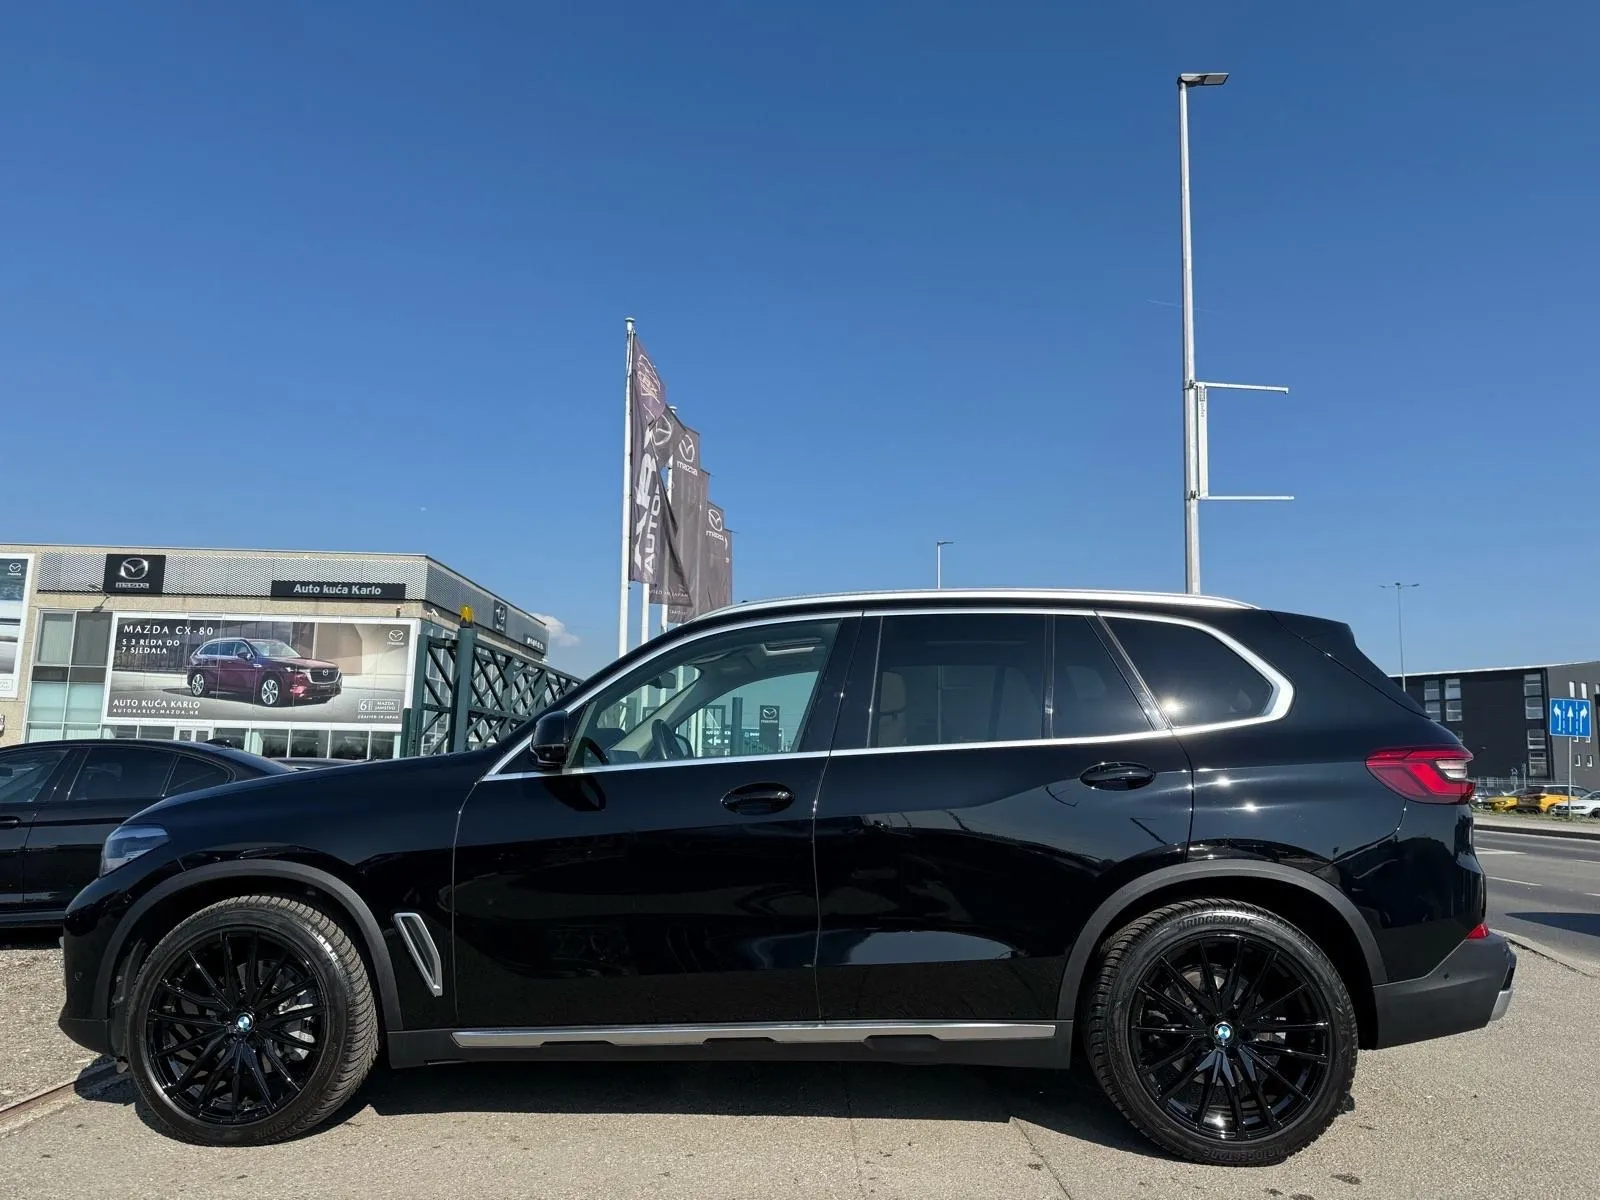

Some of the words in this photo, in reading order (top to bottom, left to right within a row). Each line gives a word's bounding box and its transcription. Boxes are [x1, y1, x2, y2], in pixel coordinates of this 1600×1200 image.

[115, 581, 150, 589] mazda
[293, 583, 320, 593] Auto
[323, 584, 349, 594] kuća
[351, 585, 382, 595] Karlo
[123, 625, 170, 635] MAZDA
[175, 626, 214, 636] CX-80
[139, 638, 163, 646] REDA
[166, 639, 180, 647] DO
[112, 699, 139, 707] AUTO
[141, 698, 168, 708] KUĆA
[170, 700, 201, 709] KARLO
[360, 700, 367, 711] 6
